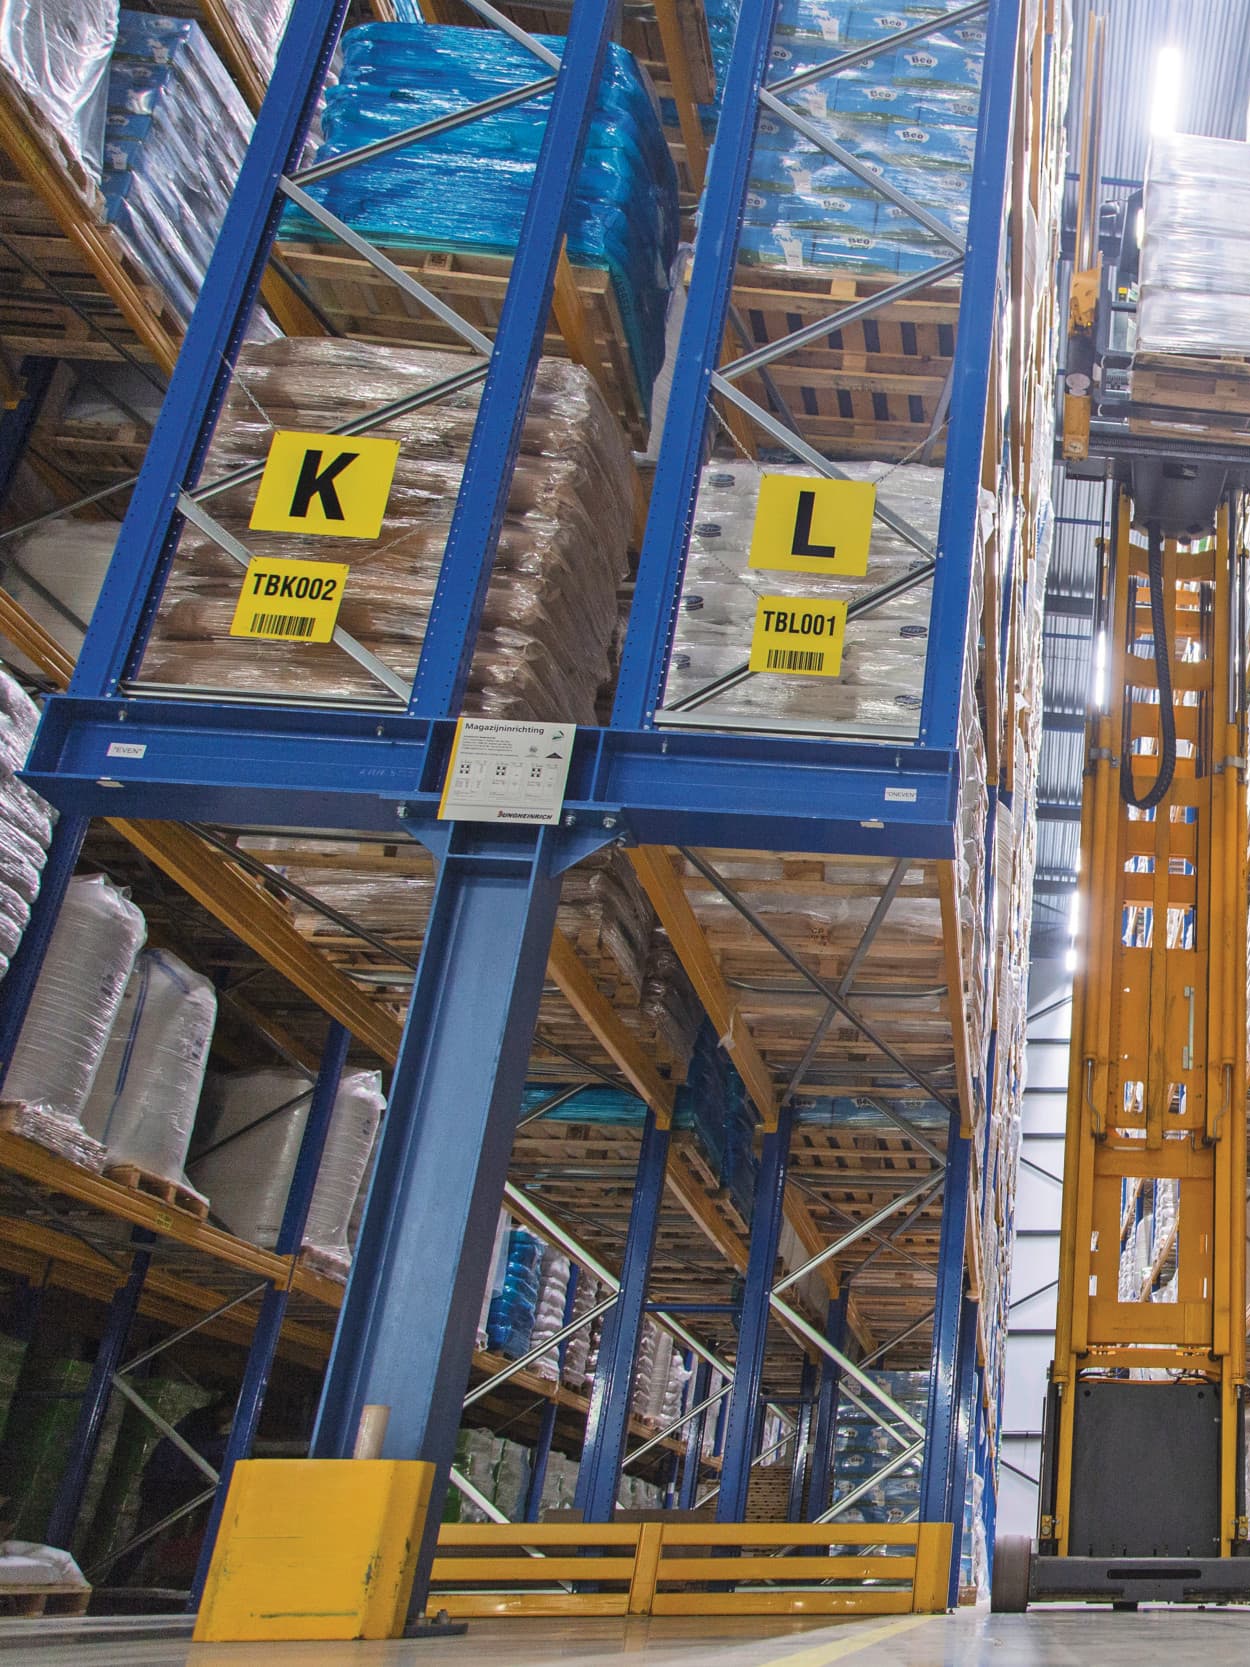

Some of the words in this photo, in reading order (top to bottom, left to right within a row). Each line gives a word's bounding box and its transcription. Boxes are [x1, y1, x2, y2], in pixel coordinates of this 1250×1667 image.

[289, 449, 360, 521] K
[791, 490, 836, 558] L
[252, 572, 338, 601] TBK002
[762, 610, 837, 637] TBL001
[465, 722, 545, 736] Magazijninrichting
